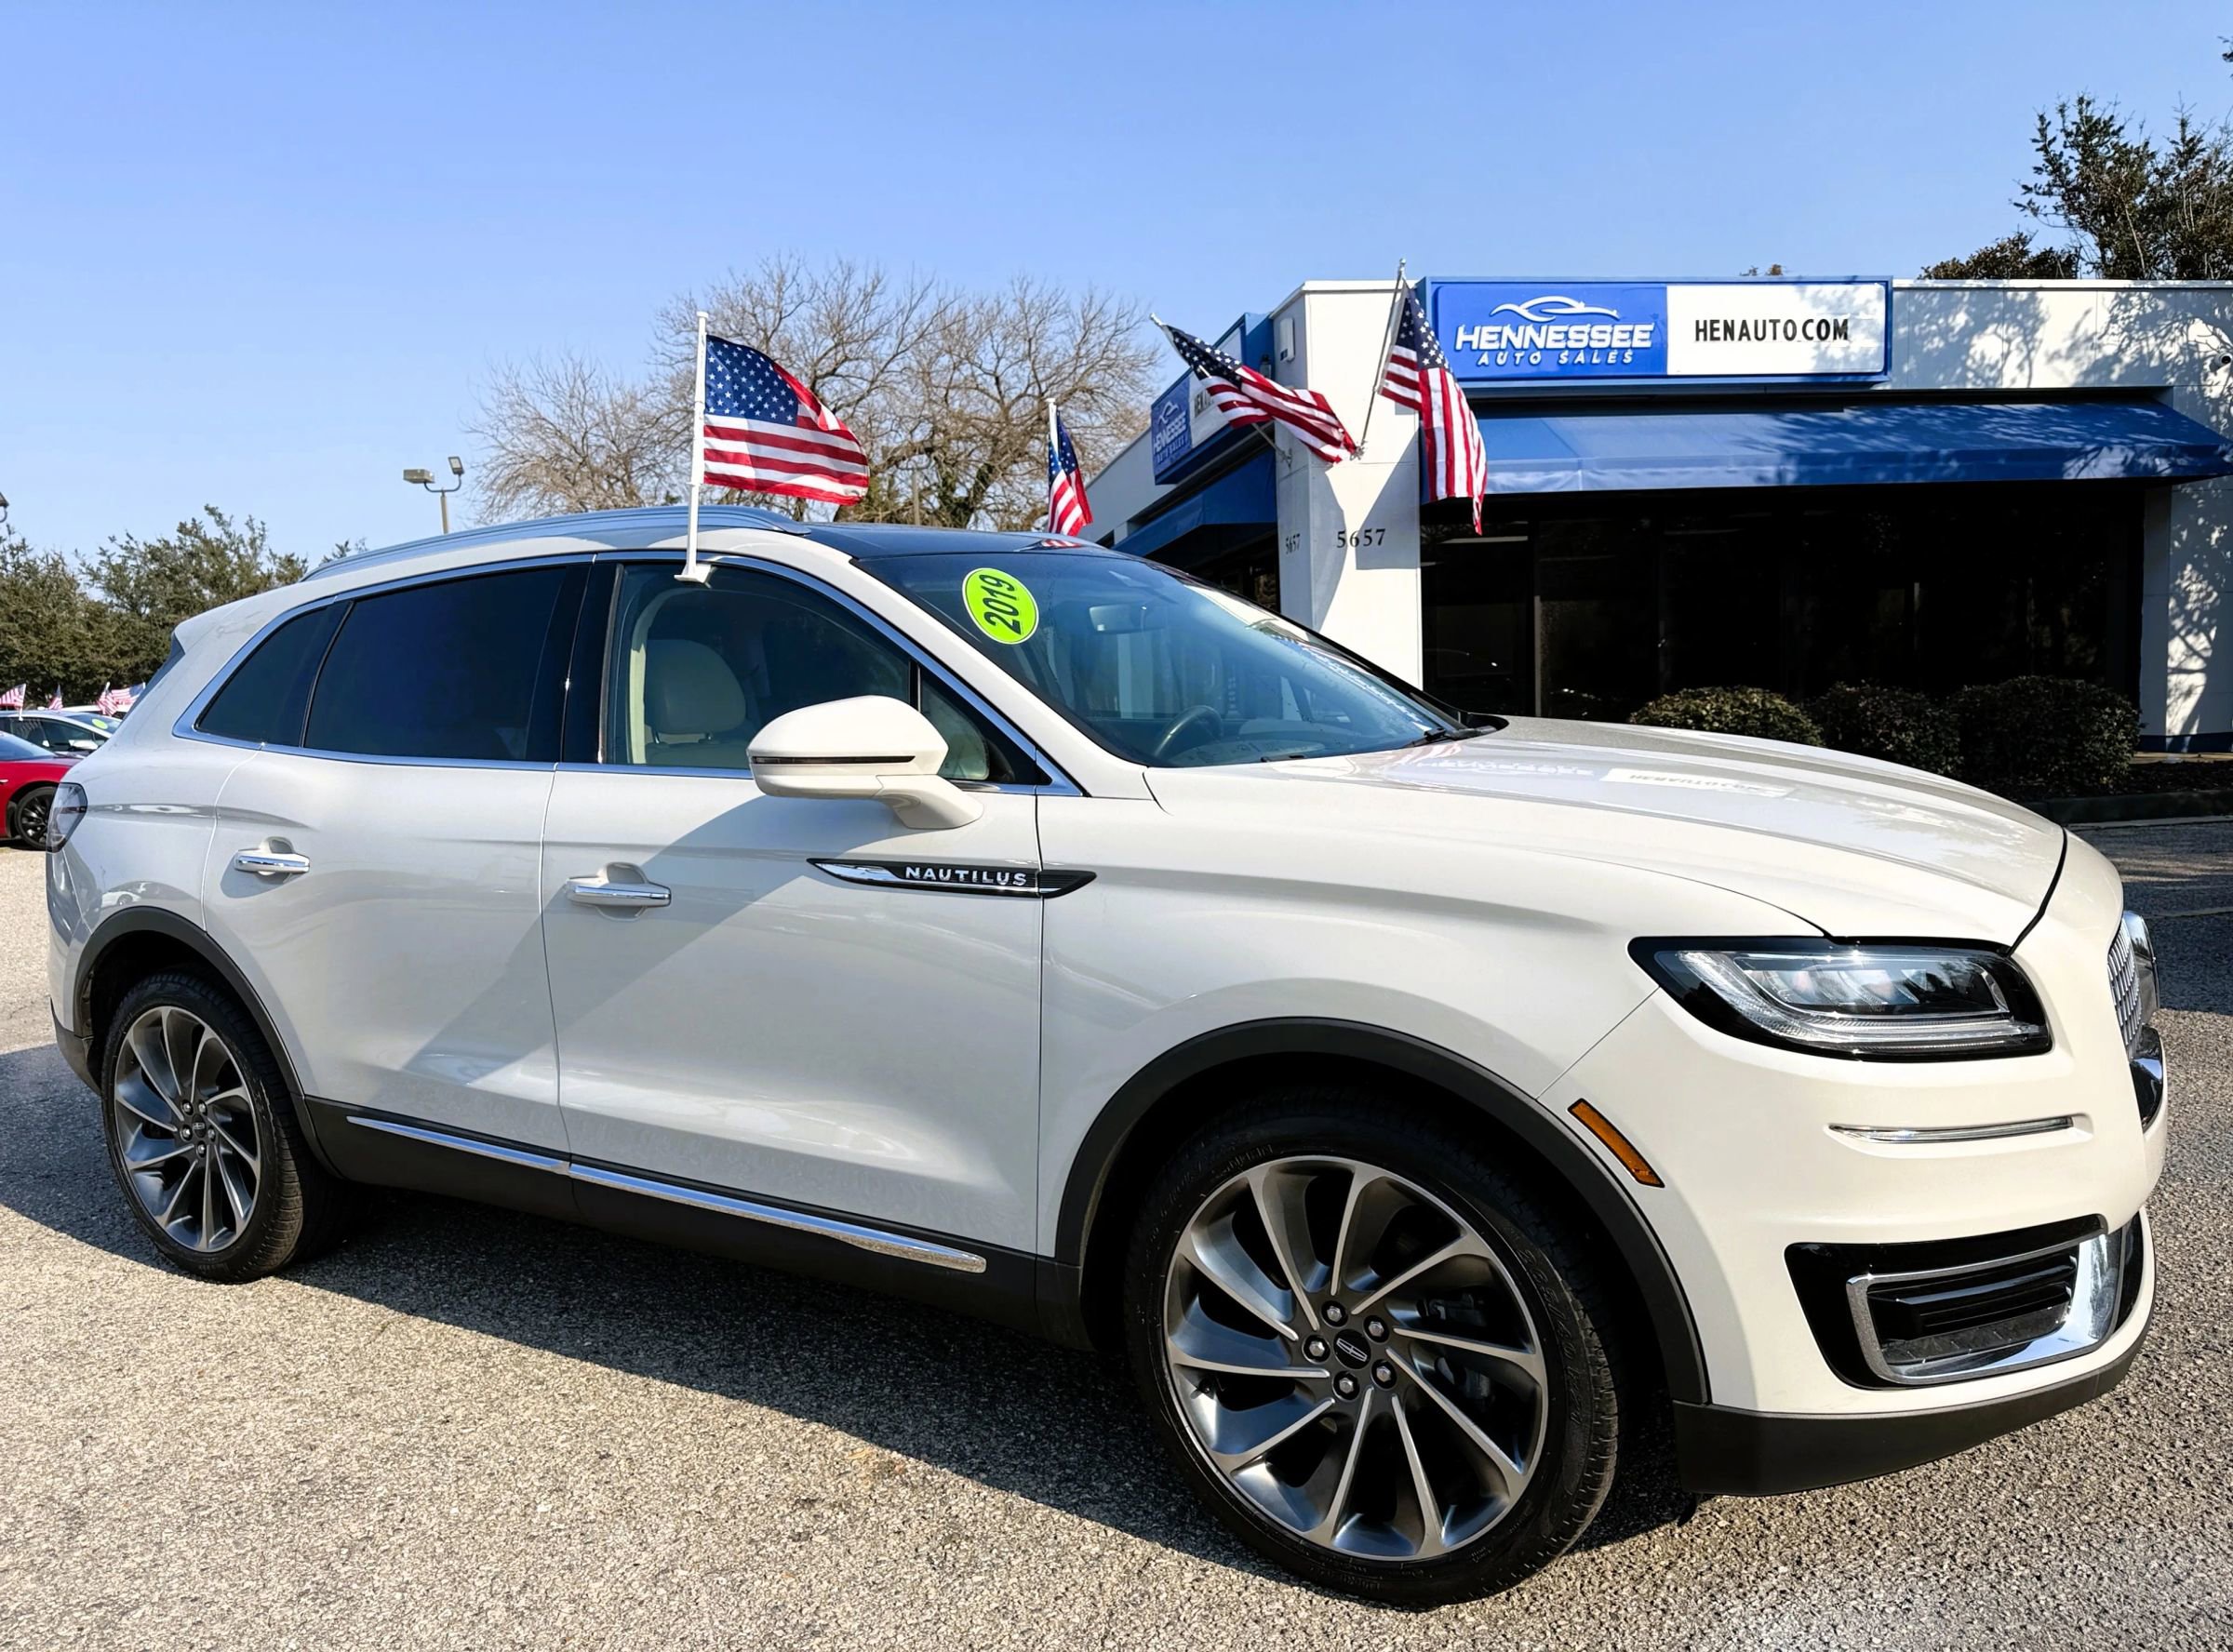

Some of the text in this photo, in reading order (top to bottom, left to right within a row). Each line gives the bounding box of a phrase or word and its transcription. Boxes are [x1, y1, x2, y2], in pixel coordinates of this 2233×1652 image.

[1454, 322, 1655, 351] HENNESSEE
[1694, 318, 1850, 342] HENAUTO.COM
[1477, 349, 1634, 366] AUTO SALES
[1336, 527, 1386, 549] 5657
[978, 574, 1022, 635] 2019
[905, 865, 1028, 886] NAUTILUS
